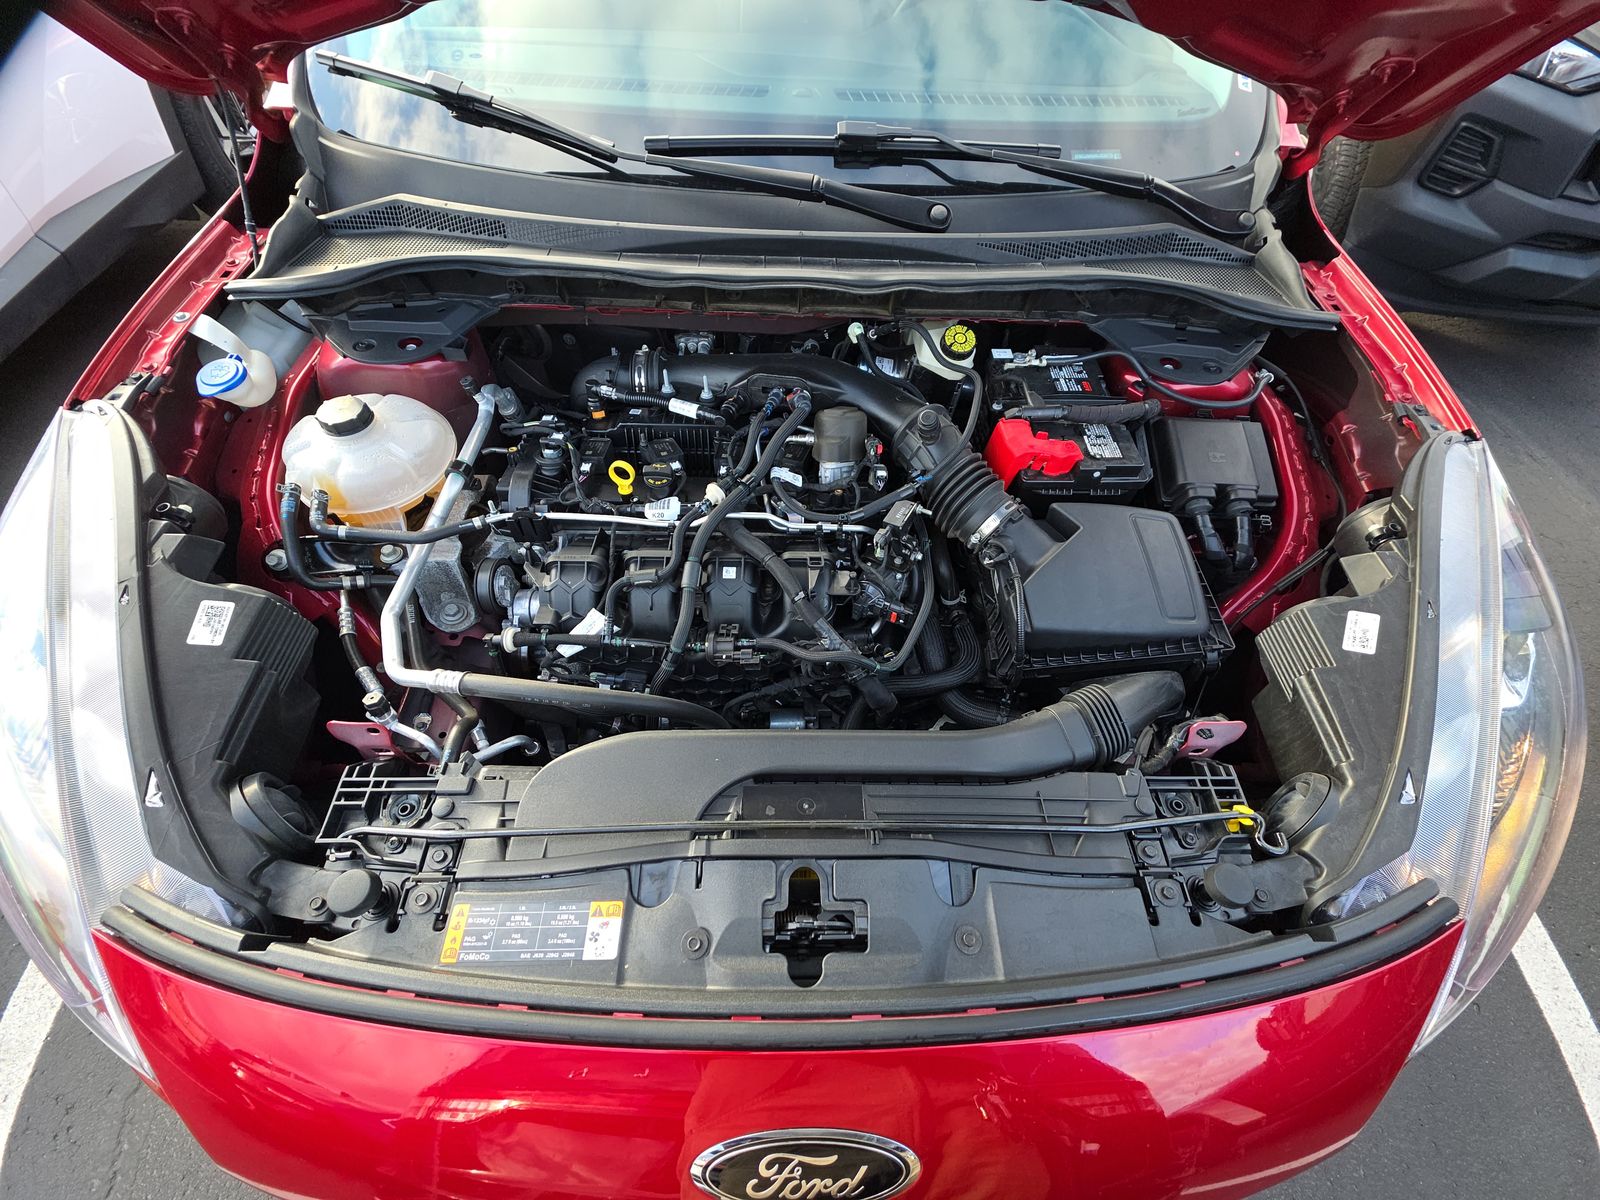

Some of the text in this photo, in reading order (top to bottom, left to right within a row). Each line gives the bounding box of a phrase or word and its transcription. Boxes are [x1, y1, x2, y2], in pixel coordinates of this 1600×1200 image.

[652, 511, 665, 519] K20
[459, 952, 490, 961] FoMoCo
[746, 1152, 868, 1200] Ford
